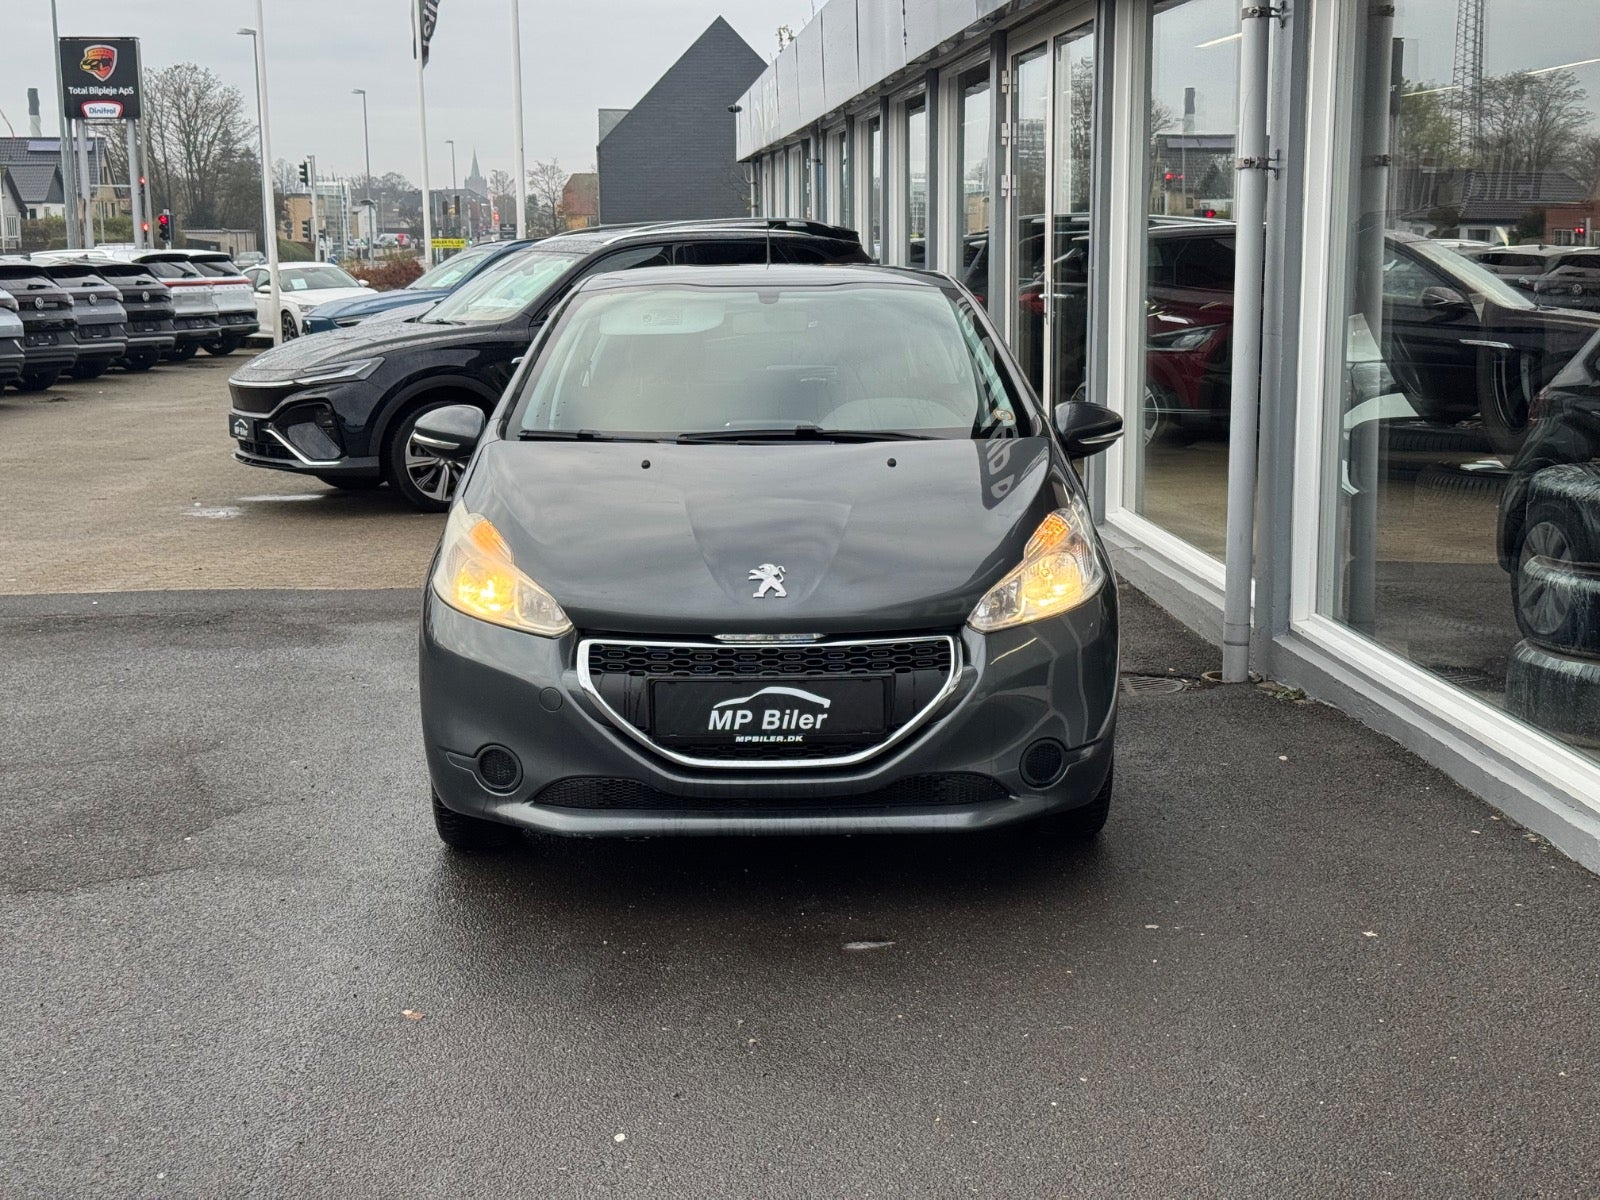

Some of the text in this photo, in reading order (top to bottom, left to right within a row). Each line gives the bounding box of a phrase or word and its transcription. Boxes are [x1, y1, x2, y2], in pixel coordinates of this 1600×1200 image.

[68, 86, 134, 96] Total Bilpleje ApS
[708, 709, 828, 730] MP Biler
[735, 735, 803, 743] MPBILER.DK
